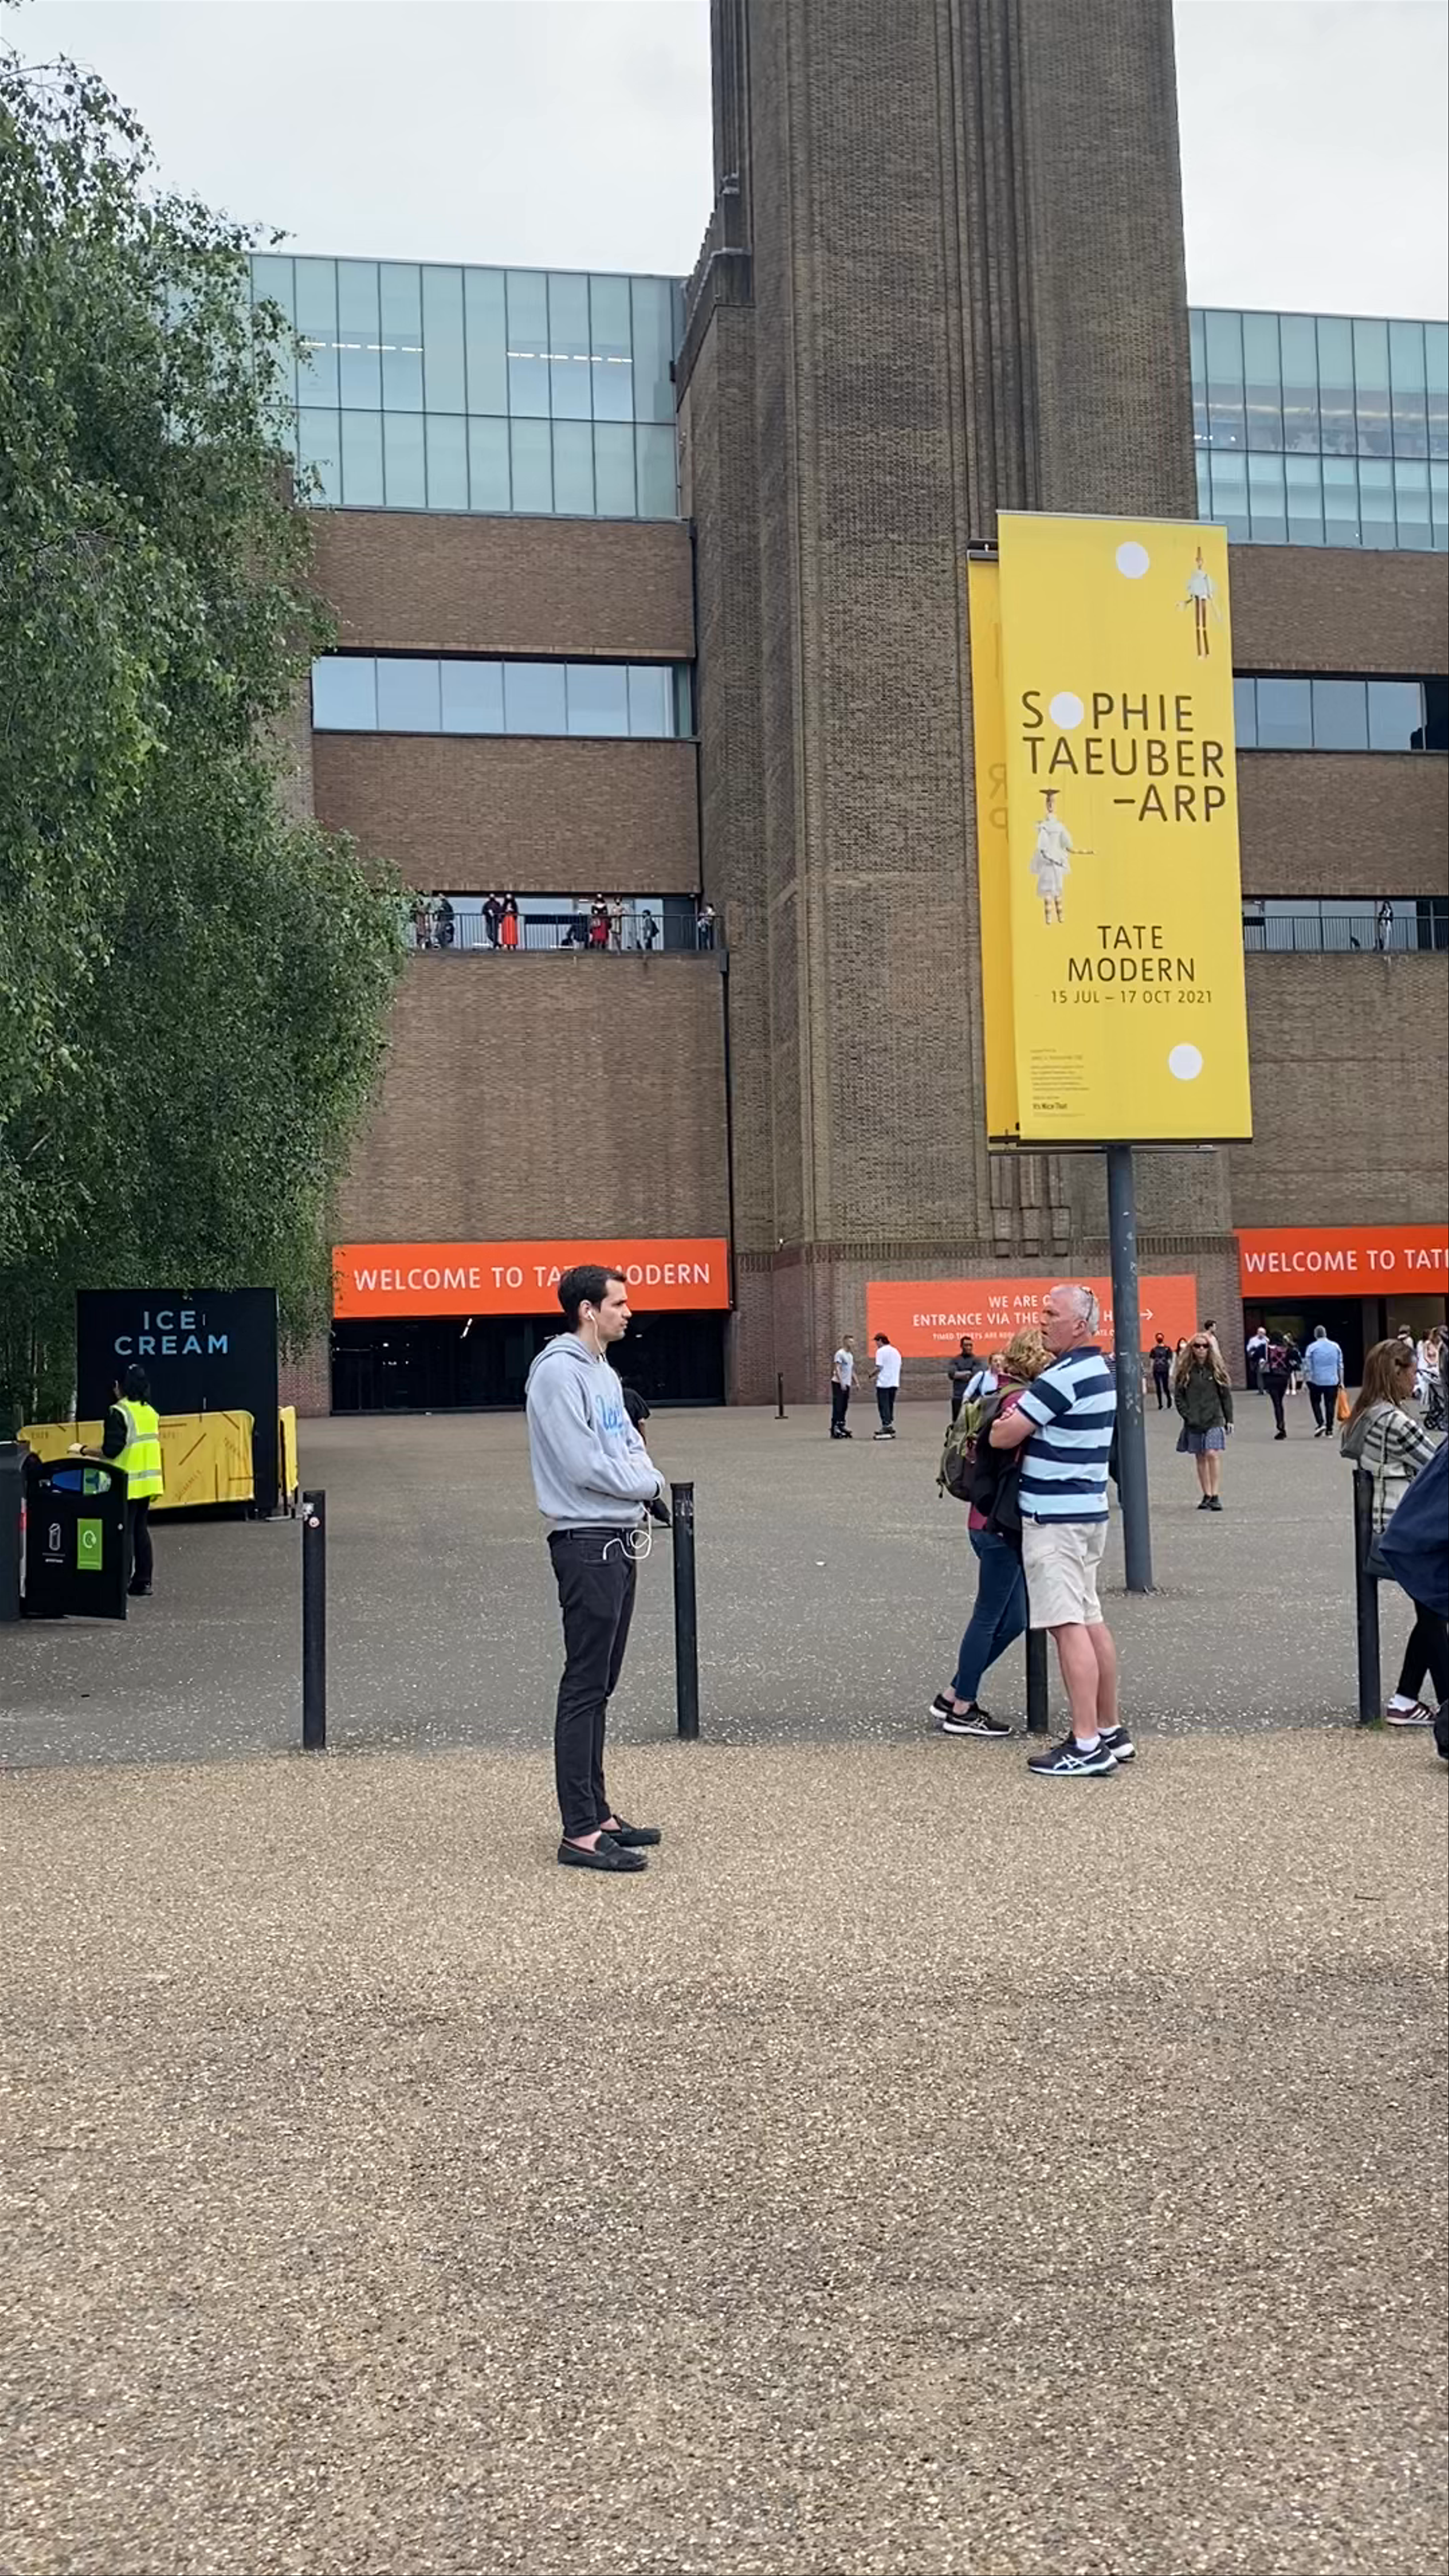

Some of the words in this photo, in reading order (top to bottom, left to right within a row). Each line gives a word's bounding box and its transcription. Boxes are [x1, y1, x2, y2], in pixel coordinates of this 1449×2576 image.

[1022, 736, 1224, 778] TAEUBER
[1097, 926, 1164, 949] TATE
[1068, 958, 1195, 982] MODERN
[1051, 990, 1068, 1004] 15
[1074, 990, 1100, 1004] JUL
[1121, 990, 1136, 1004] 17
[1143, 990, 1171, 1004] OCT
[1178, 990, 1212, 1003] 2021
[1245, 1250, 1358, 1272] WELCOME
[1367, 1249, 1395, 1270] TO
[354, 1267, 481, 1291] WELCOME
[491, 1266, 523, 1288] TO
[533, 1265, 578, 1287] TA
[605, 1263, 710, 1285] ODERN
[988, 1296, 1009, 1308] WE
[1014, 1295, 1038, 1307] ARE
[143, 1310, 196, 1330] ICE
[912, 1313, 982, 1327] ENTRANCE
[987, 1313, 1010, 1325] VIA
[1014, 1312, 1039, 1324] THE
[114, 1335, 229, 1356] CREAM
